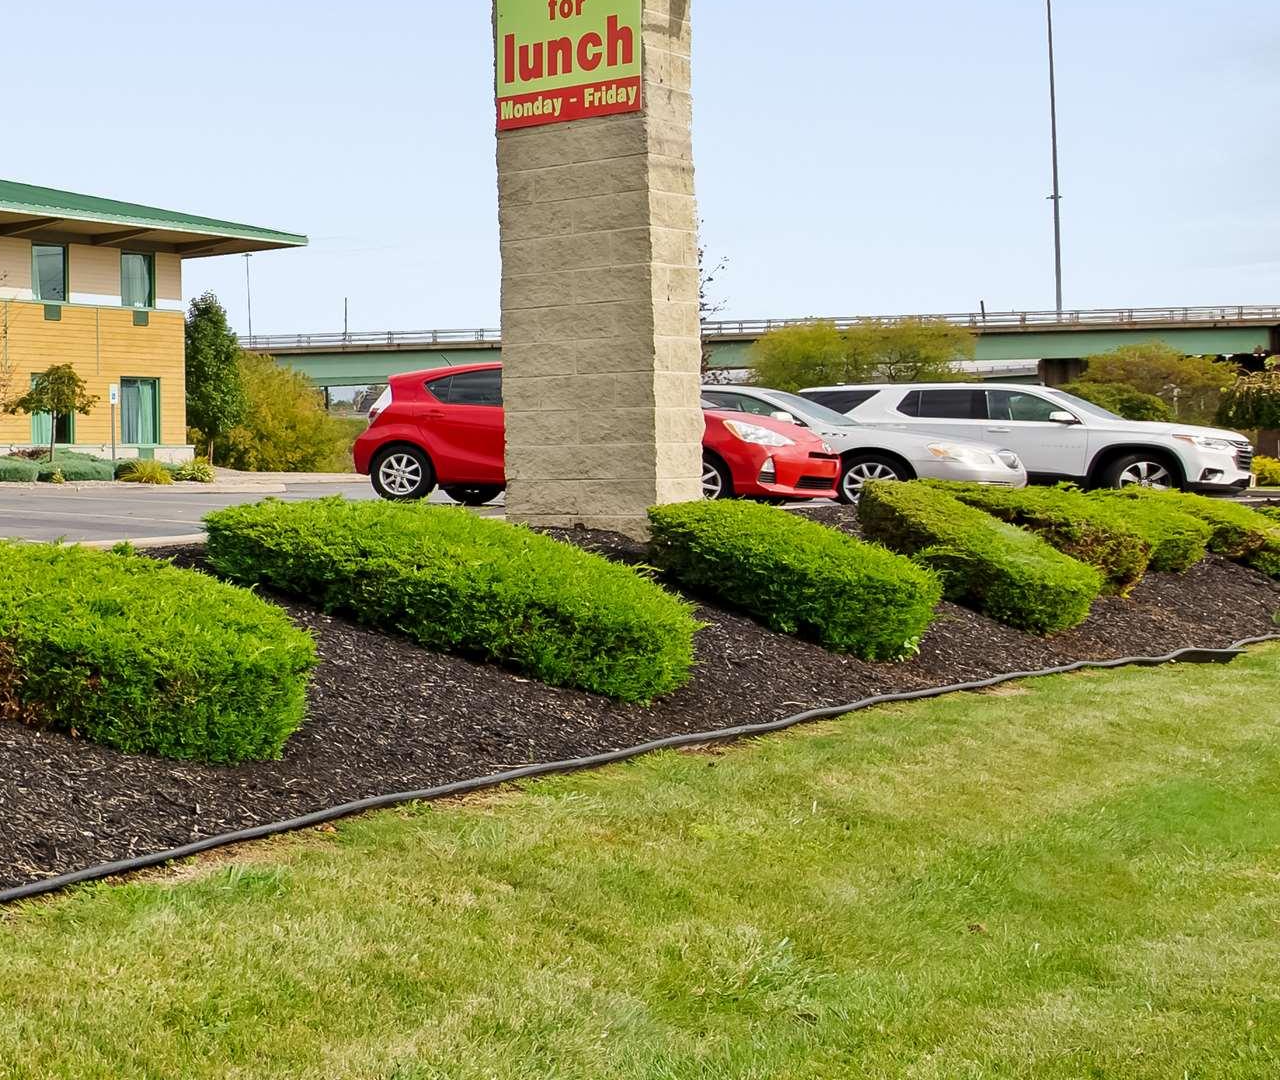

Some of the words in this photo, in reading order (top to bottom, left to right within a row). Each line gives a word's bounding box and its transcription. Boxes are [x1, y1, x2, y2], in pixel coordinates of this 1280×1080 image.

[504, 15, 634, 85] lunch
[500, 95, 562, 120] Monday
[584, 84, 638, 108] Friday
